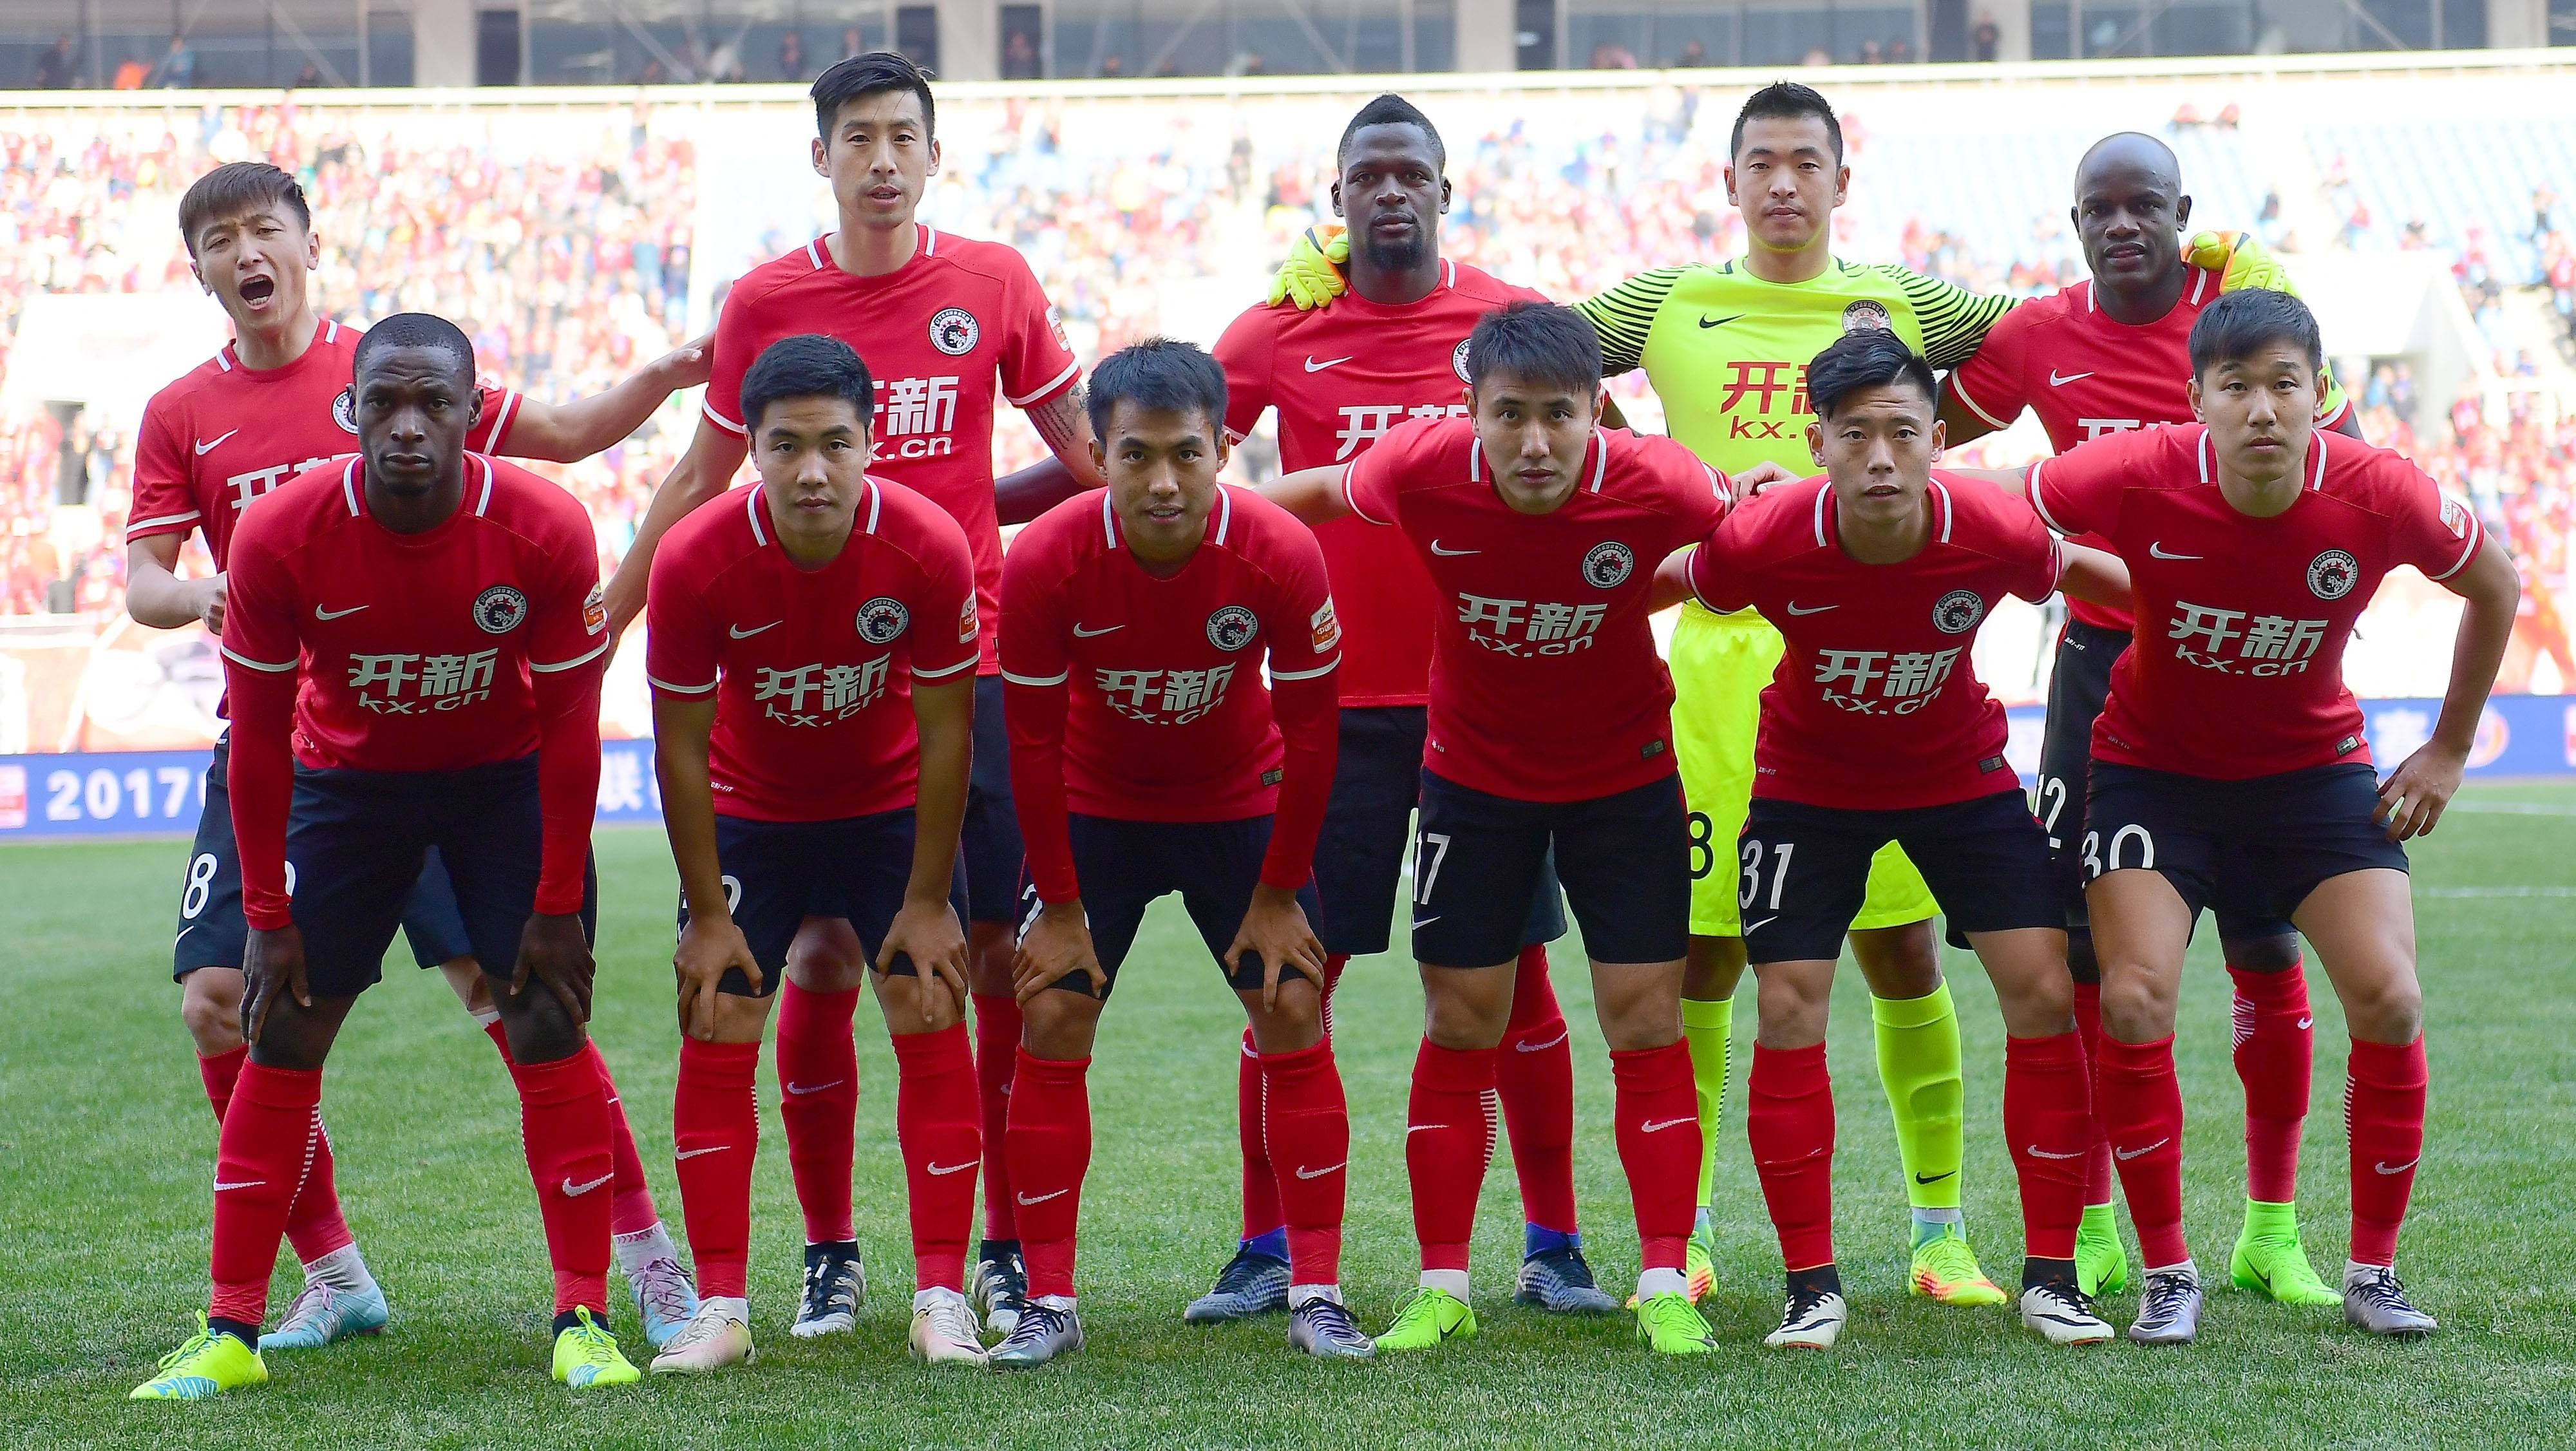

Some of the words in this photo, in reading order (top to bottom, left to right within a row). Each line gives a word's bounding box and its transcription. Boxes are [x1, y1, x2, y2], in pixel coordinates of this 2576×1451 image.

[872, 376, 959, 435] 新
[1336, 404, 1470, 461] 开
[1458, 593, 1607, 641] 开新
[2168, 600, 2328, 659] 开新
[1469, 627, 1592, 657] kx.cn
[2175, 645, 2309, 677] kx.cn
[348, 648, 498, 696] 开新
[755, 652, 889, 710] 开新
[1096, 661, 1235, 712] 开新
[1815, 646, 1962, 697] 开新
[358, 690, 488, 715] kx.cn
[766, 688, 884, 727] kx.cn
[1107, 697, 1223, 725] kx.cn
[1822, 686, 1943, 716] kx.cn
[45, 768, 207, 821] 2017
[1739, 839, 1794, 909] 31
